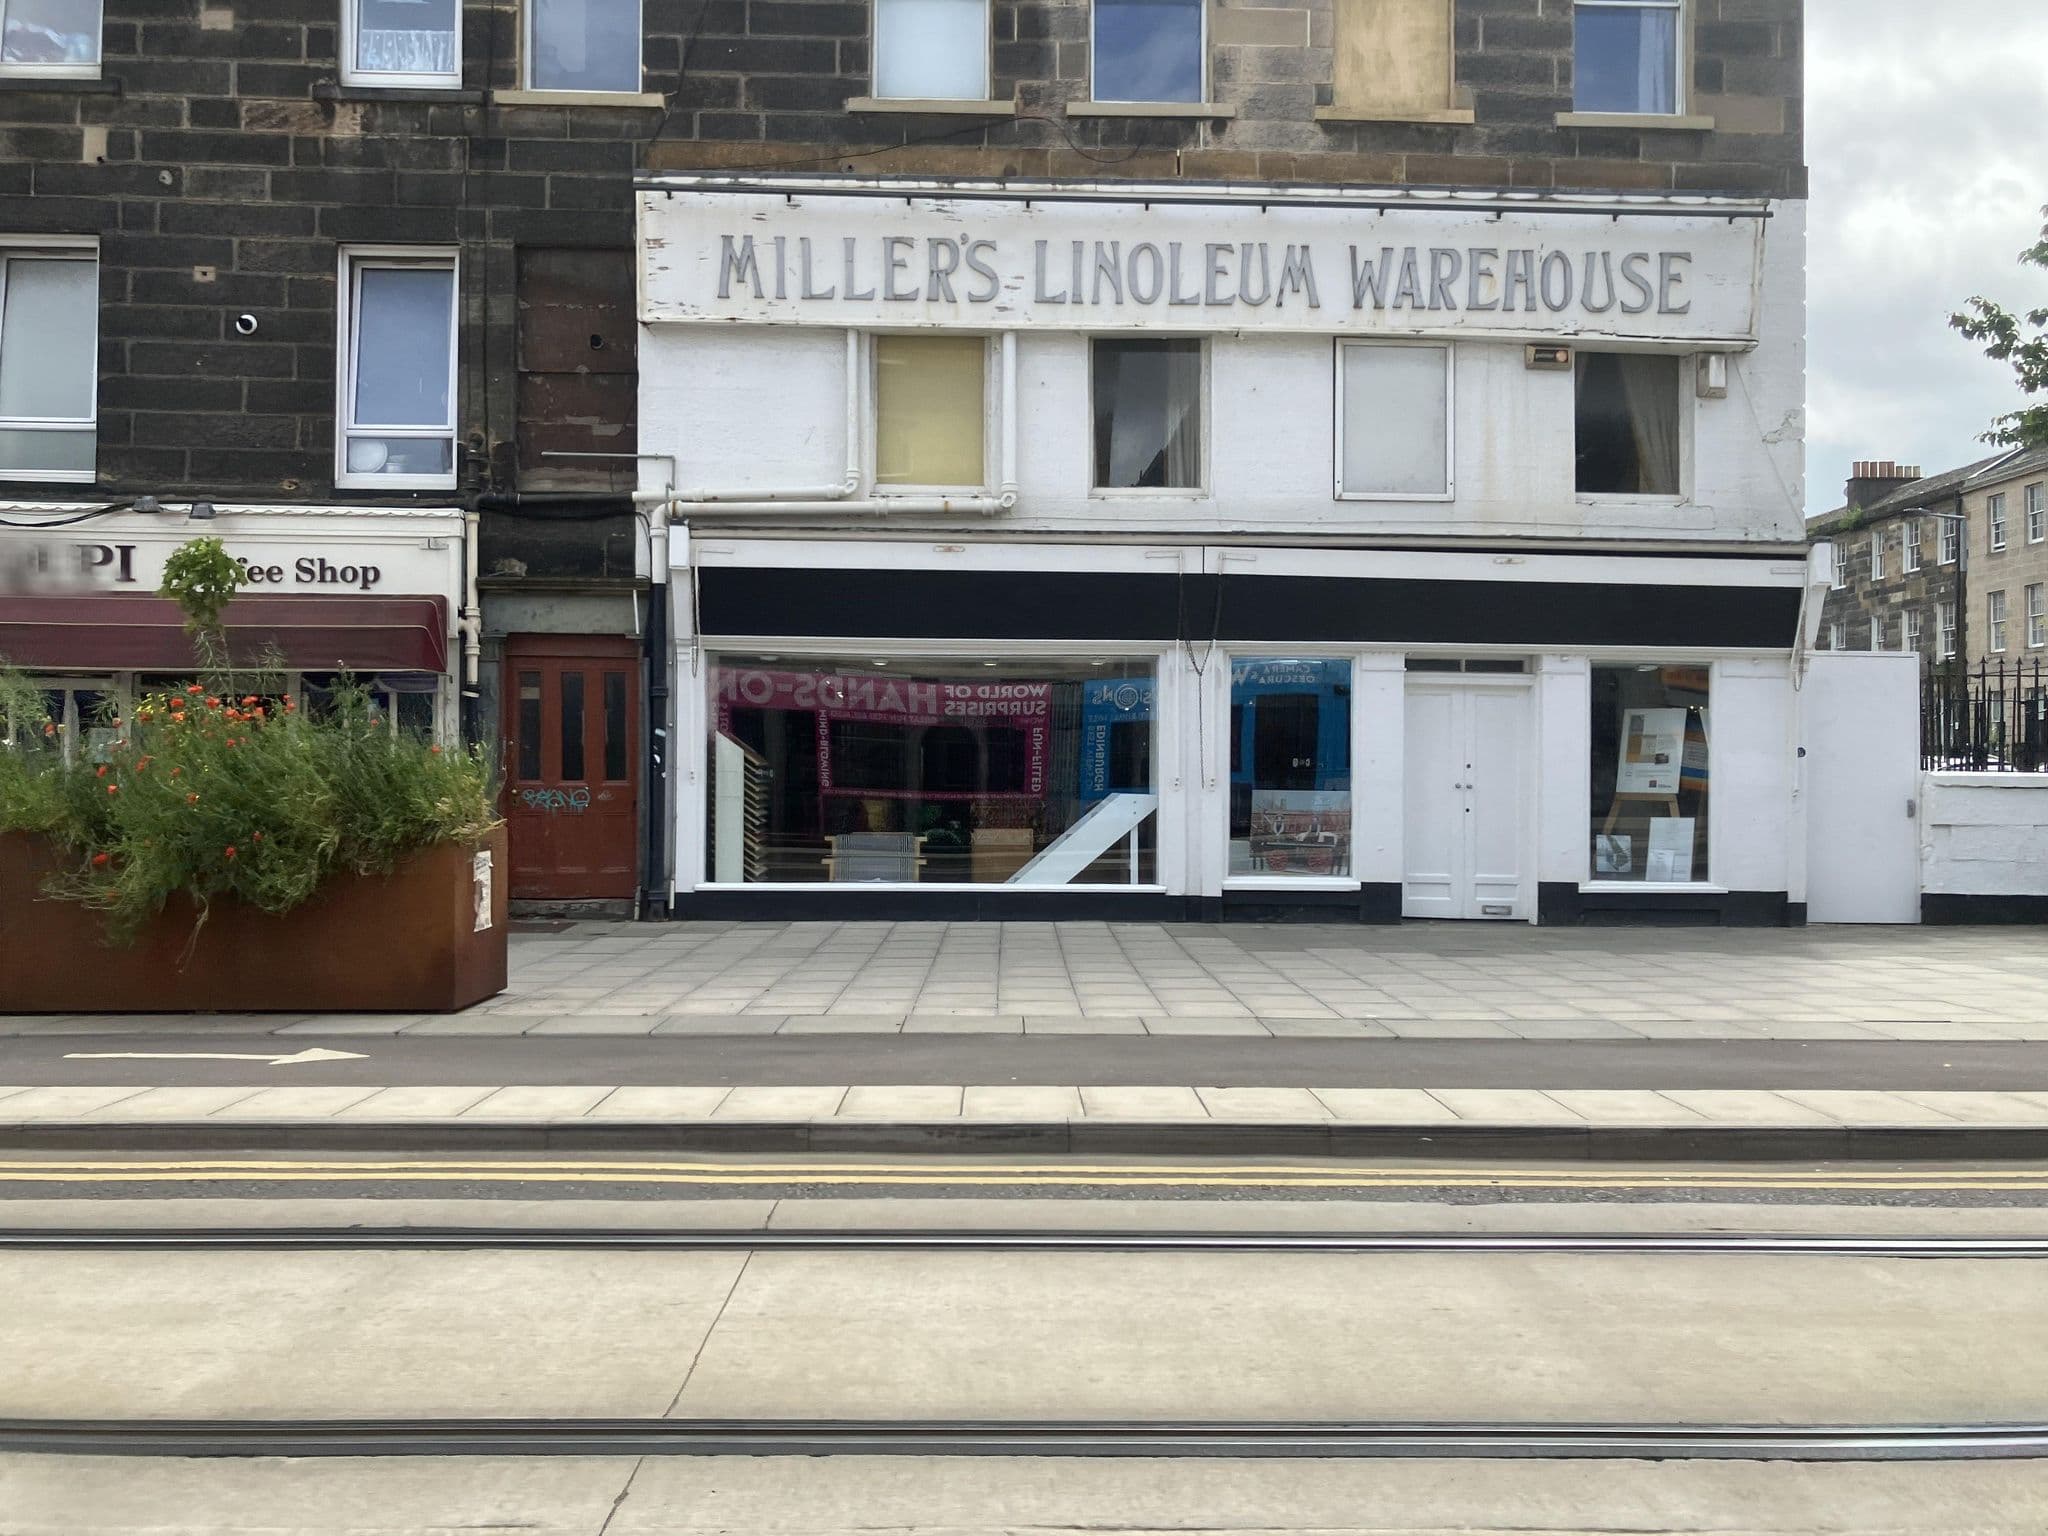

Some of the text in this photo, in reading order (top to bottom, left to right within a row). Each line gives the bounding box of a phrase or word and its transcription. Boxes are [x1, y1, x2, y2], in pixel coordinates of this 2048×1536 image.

[717, 232, 1692, 315] MILLER'S LINOLEUM WAREHOUSE
[295, 557, 381, 590] Shop
